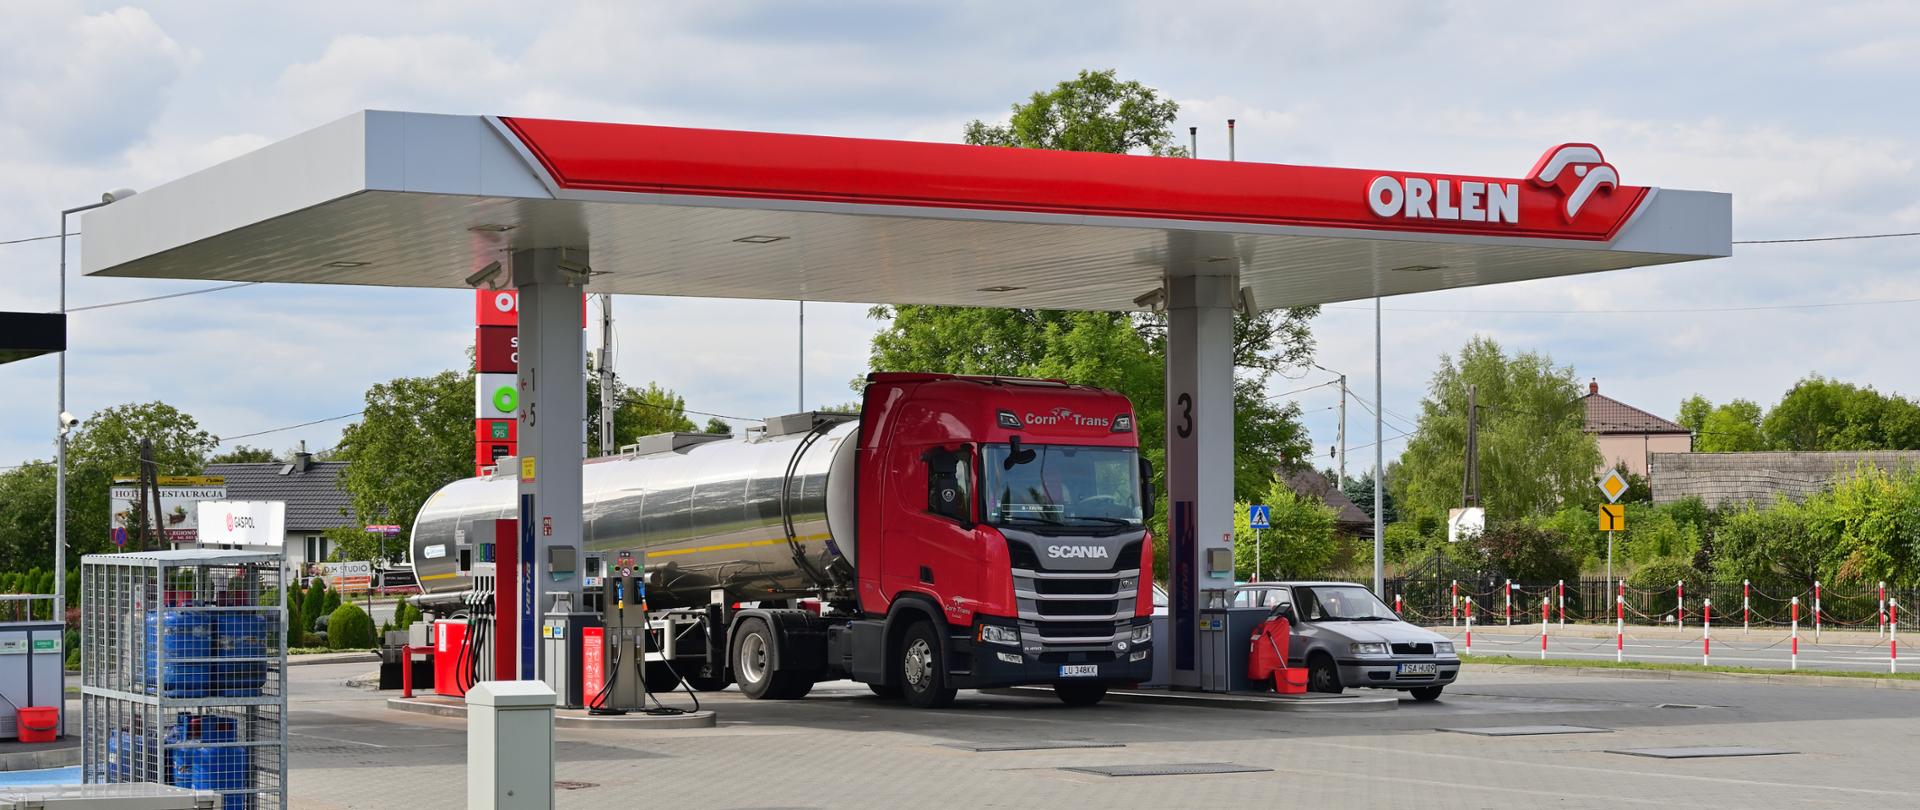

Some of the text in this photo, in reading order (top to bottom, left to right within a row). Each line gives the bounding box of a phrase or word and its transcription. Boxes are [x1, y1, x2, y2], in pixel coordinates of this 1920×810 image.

[1368, 175, 1519, 224] ORLEN
[530, 367, 536, 392] 1
[529, 402, 536, 428] 5
[1025, 412, 1109, 427] Corn Trans
[1176, 392, 1193, 439] 3
[494, 429, 505, 438] 95
[234, 516, 255, 529] GASPOL
[1047, 545, 1109, 558] SCANIA
[340, 564, 368, 573] STUDIO
[1064, 666, 1073, 675] LU
[1403, 664, 1417, 672] TSA
